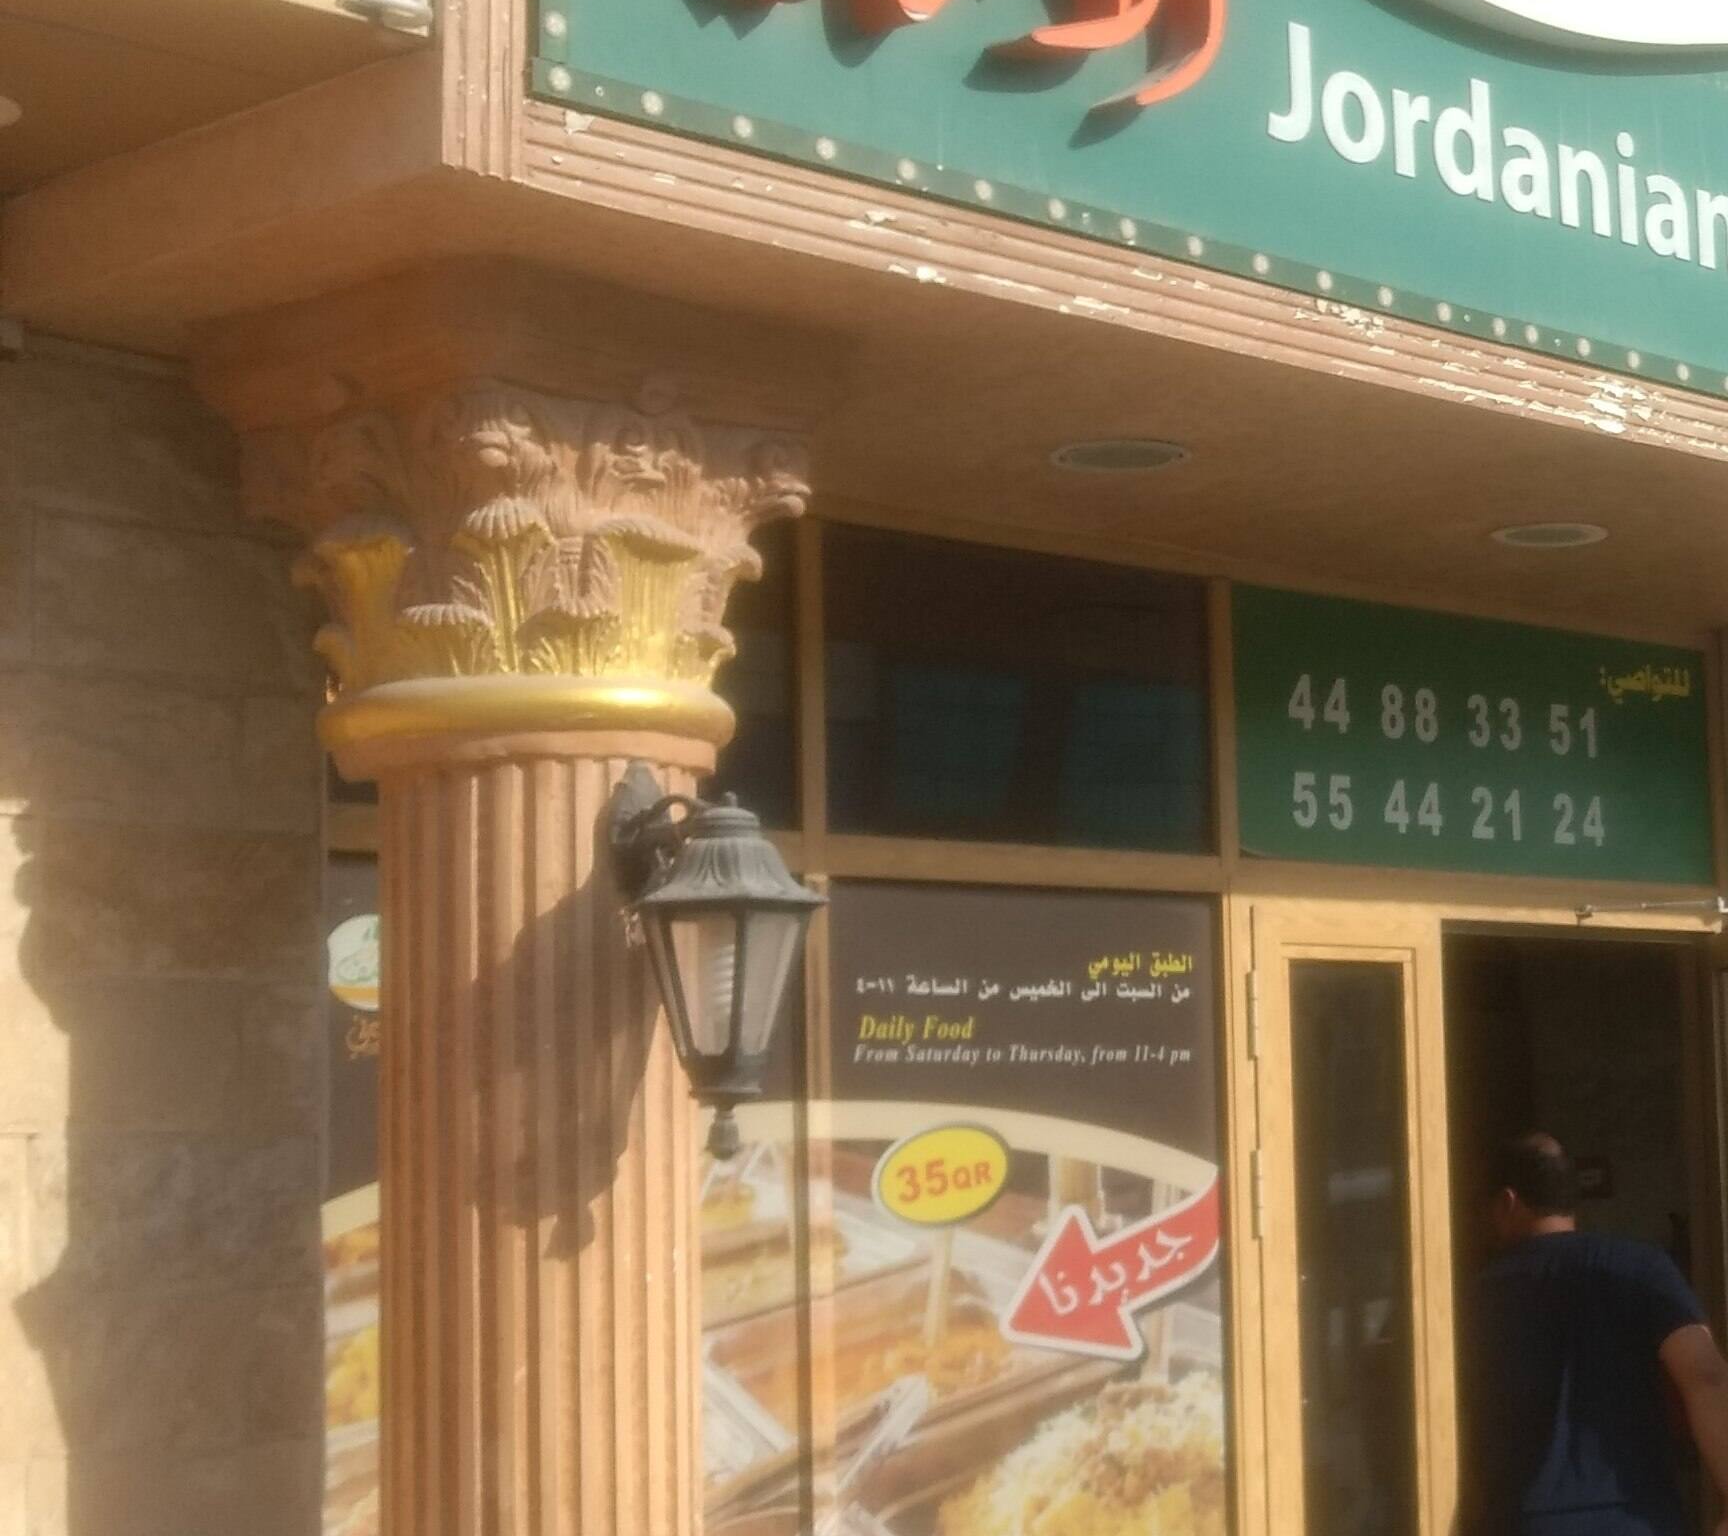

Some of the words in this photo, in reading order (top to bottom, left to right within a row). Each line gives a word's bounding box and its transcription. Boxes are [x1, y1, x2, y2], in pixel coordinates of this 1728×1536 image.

[1288, 673, 1351, 734] 44
[1381, 683, 1439, 743] 88
[1467, 694, 1522, 752] 33
[1549, 704, 1597, 759] 51
[1292, 771, 1354, 831] 55
[1384, 779, 1443, 837] 44
[1472, 786, 1522, 841] 21
[1554, 793, 1606, 847] 24
[1088, 951, 1141, 980] اليومي
[1149, 950, 1193, 979] الطبق
[977, 978, 1000, 1001] من
[1116, 980, 1163, 1003] السبت
[1170, 982, 1191, 1004] من
[858, 1014, 915, 1045] Daily
[922, 1014, 976, 1041] Food
[853, 1044, 899, 1064] From
[905, 1043, 980, 1067] Saturday
[985, 1045, 1002, 1063] to
[1090, 1043, 1127, 1066] from
[1169, 1048, 1192, 1065] pm
